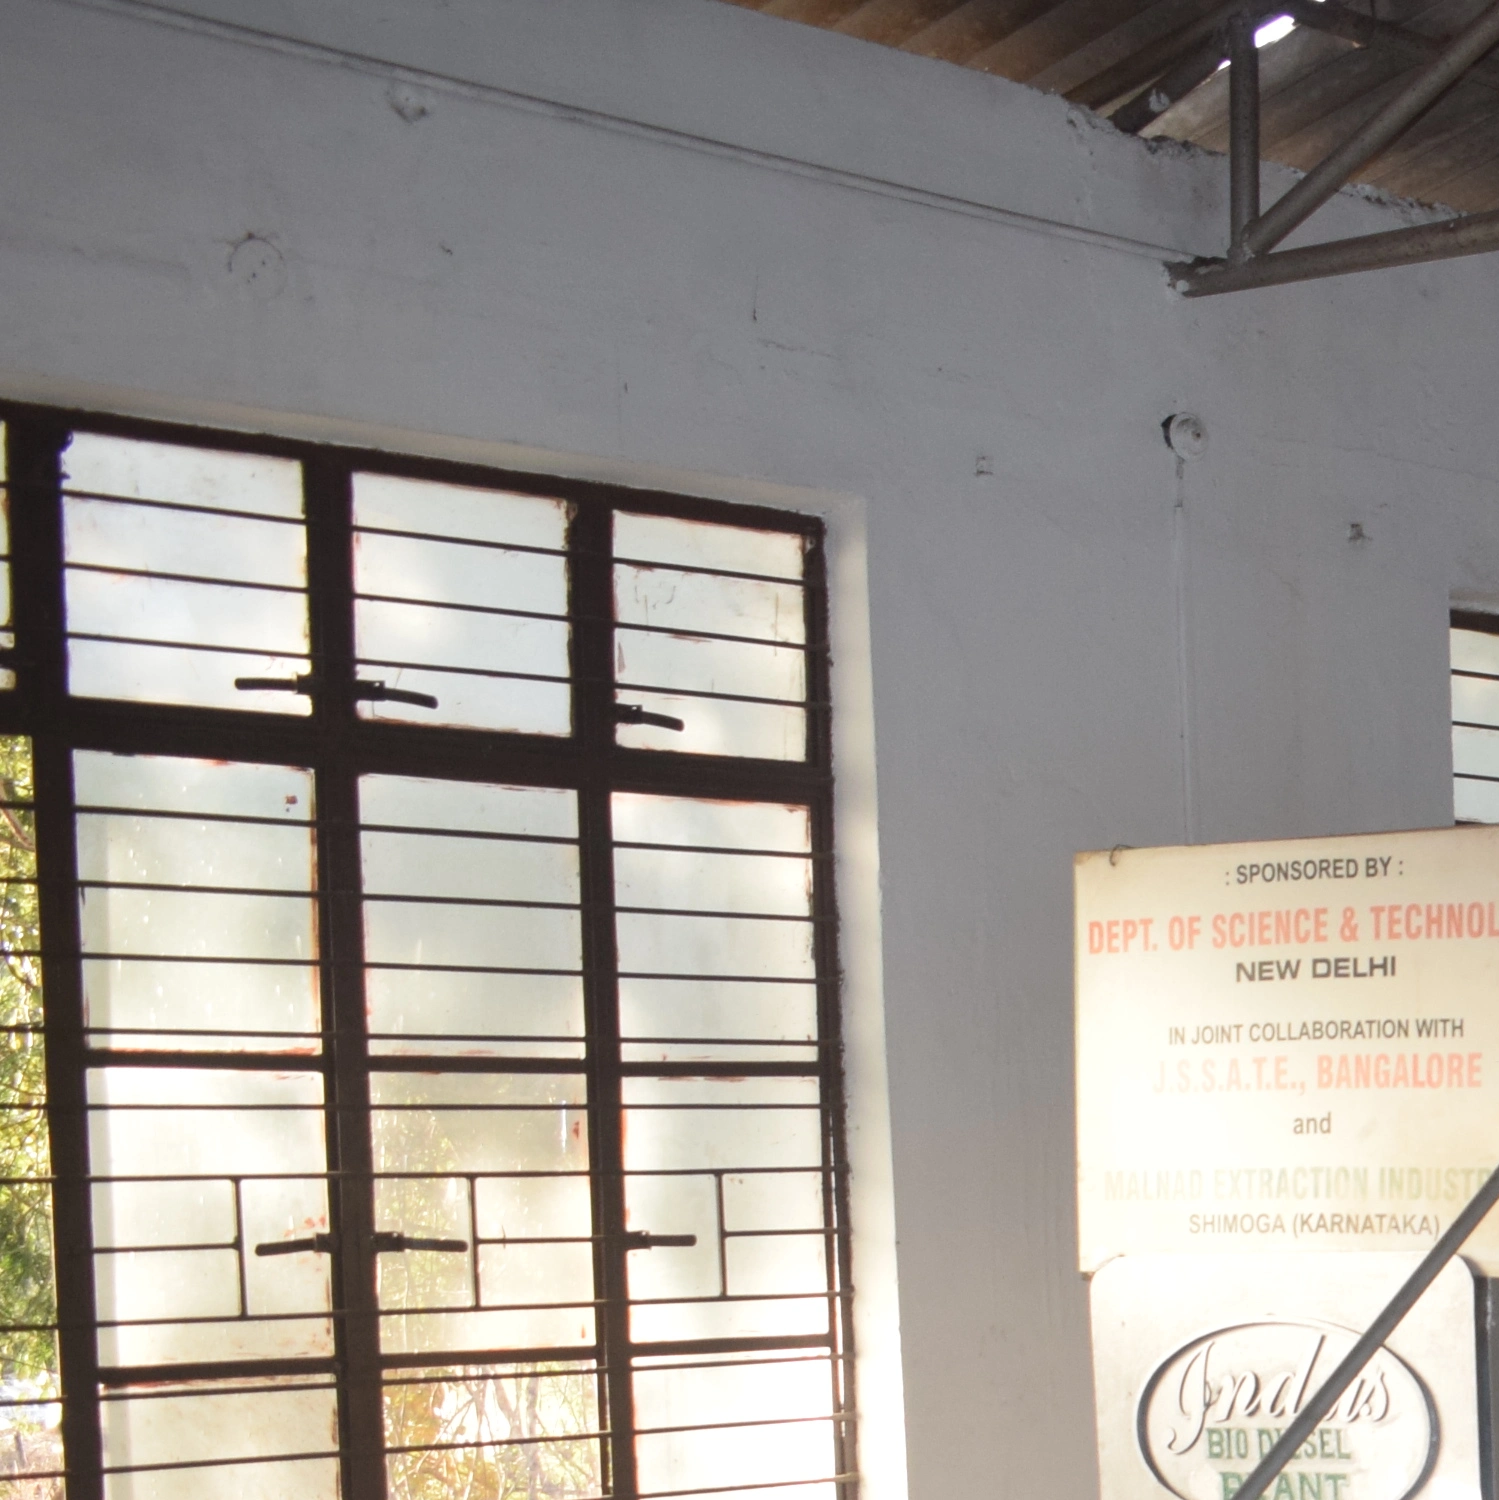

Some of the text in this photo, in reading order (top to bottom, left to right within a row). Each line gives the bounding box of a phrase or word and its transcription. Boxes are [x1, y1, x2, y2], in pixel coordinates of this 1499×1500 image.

[1236, 858, 1358, 884] SPONSORED
[1365, 856, 1392, 878] BY
[1088, 918, 1158, 954] DEPT.
[1168, 915, 1201, 951] OF
[1211, 907, 1328, 949] SCIENCE
[1339, 906, 1360, 942] &
[1236, 956, 1396, 982] NEW DELHI
[1169, 1018, 1465, 1045] IN JOINT COLLABORATION WITH
[1317, 1052, 1484, 1089] BANGALORE
[1293, 1111, 1332, 1135] and
[1105, 1170, 1202, 1202] MALNAD
[1214, 1166, 1368, 1202] EXTRACTION
[1189, 1213, 1441, 1238] SHIMOGA (KARNATAKA)
[1206, 1428, 1351, 1460] BIO DSEL
